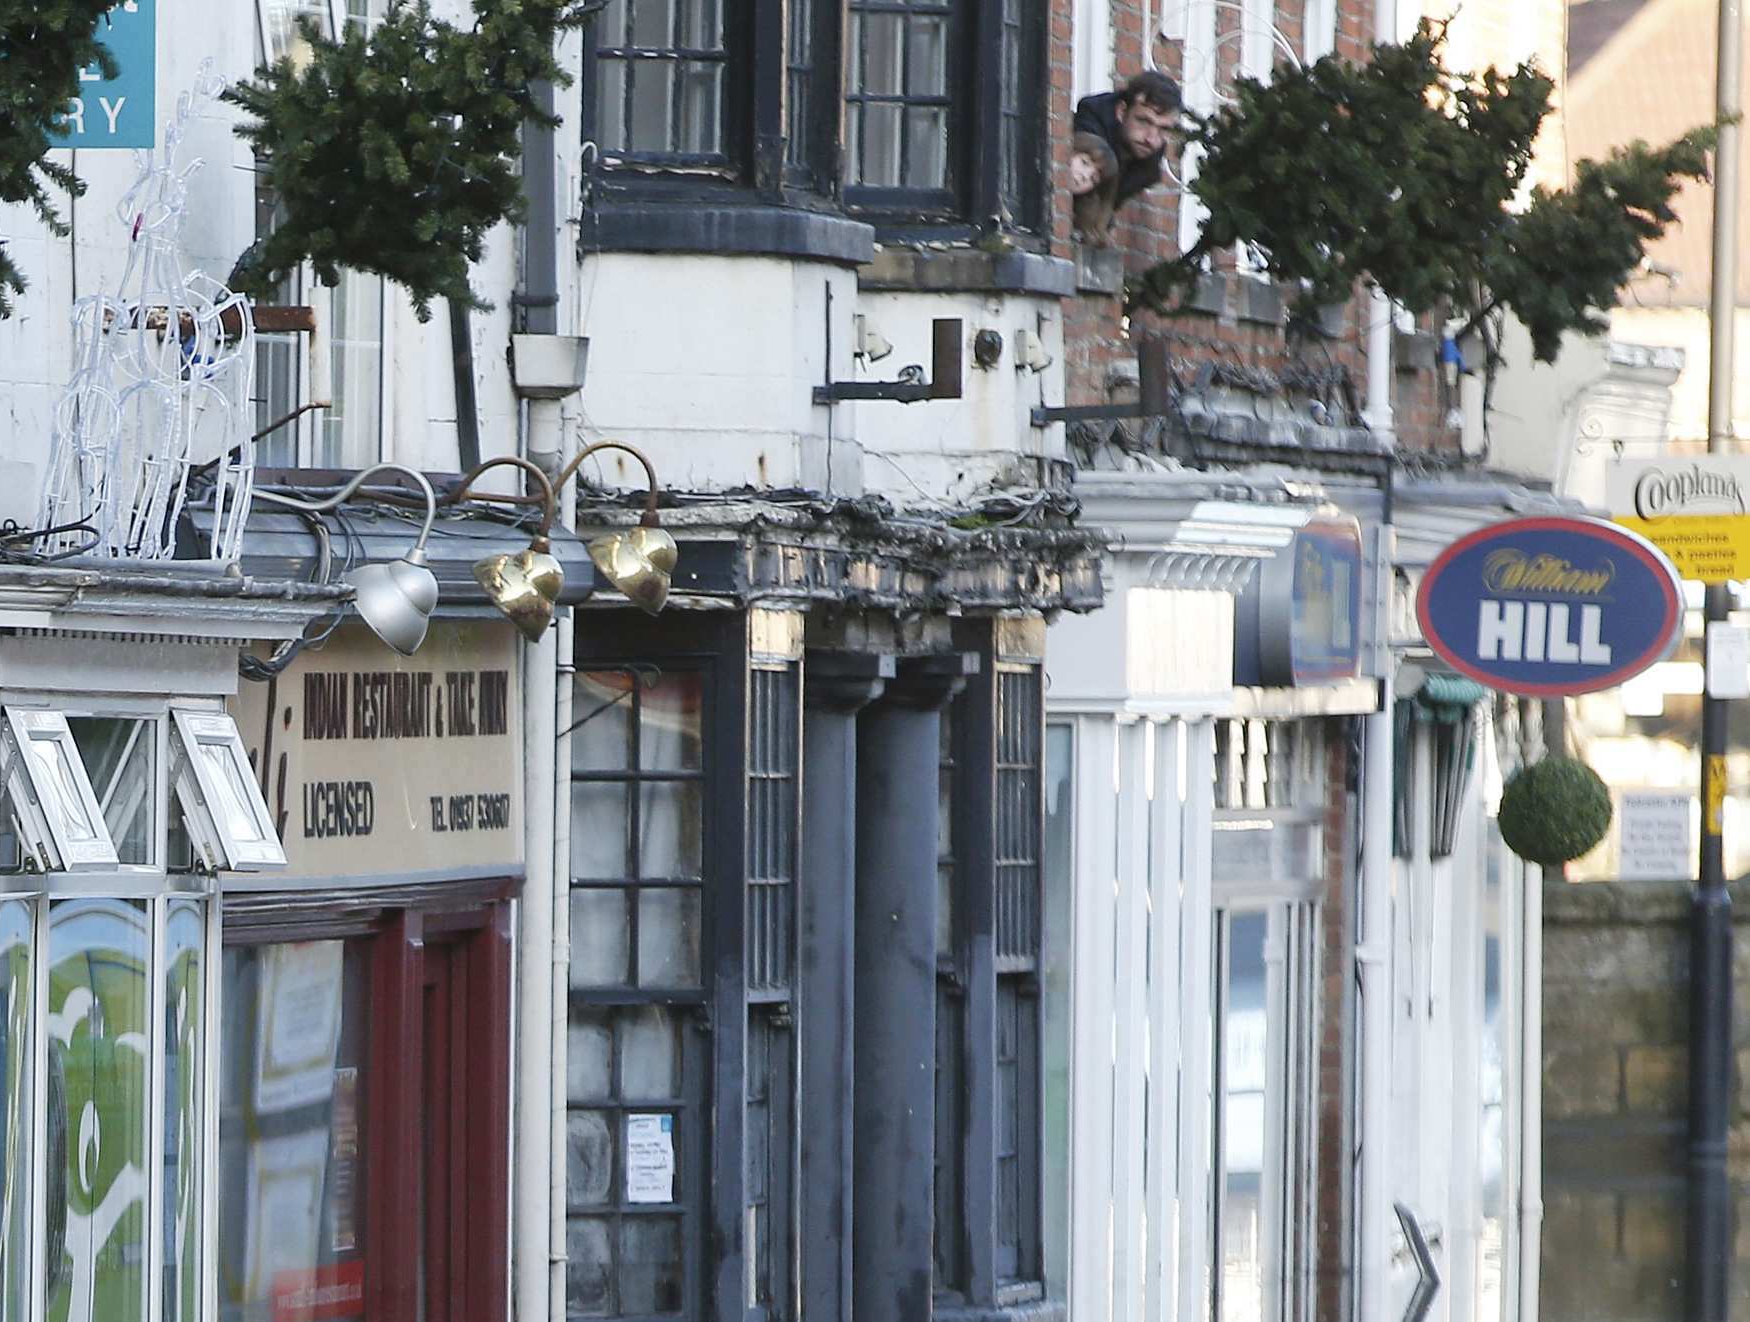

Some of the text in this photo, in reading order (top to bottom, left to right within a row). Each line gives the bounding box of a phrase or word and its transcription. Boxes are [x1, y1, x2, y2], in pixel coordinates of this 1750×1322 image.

[1481, 546, 1616, 594] William
[1477, 599, 1612, 665] HILL
[303, 672, 348, 740] INDIAN
[353, 671, 433, 740] RESTAURANT
[445, 671, 476, 737] TAKE
[303, 781, 375, 839] LICENSED
